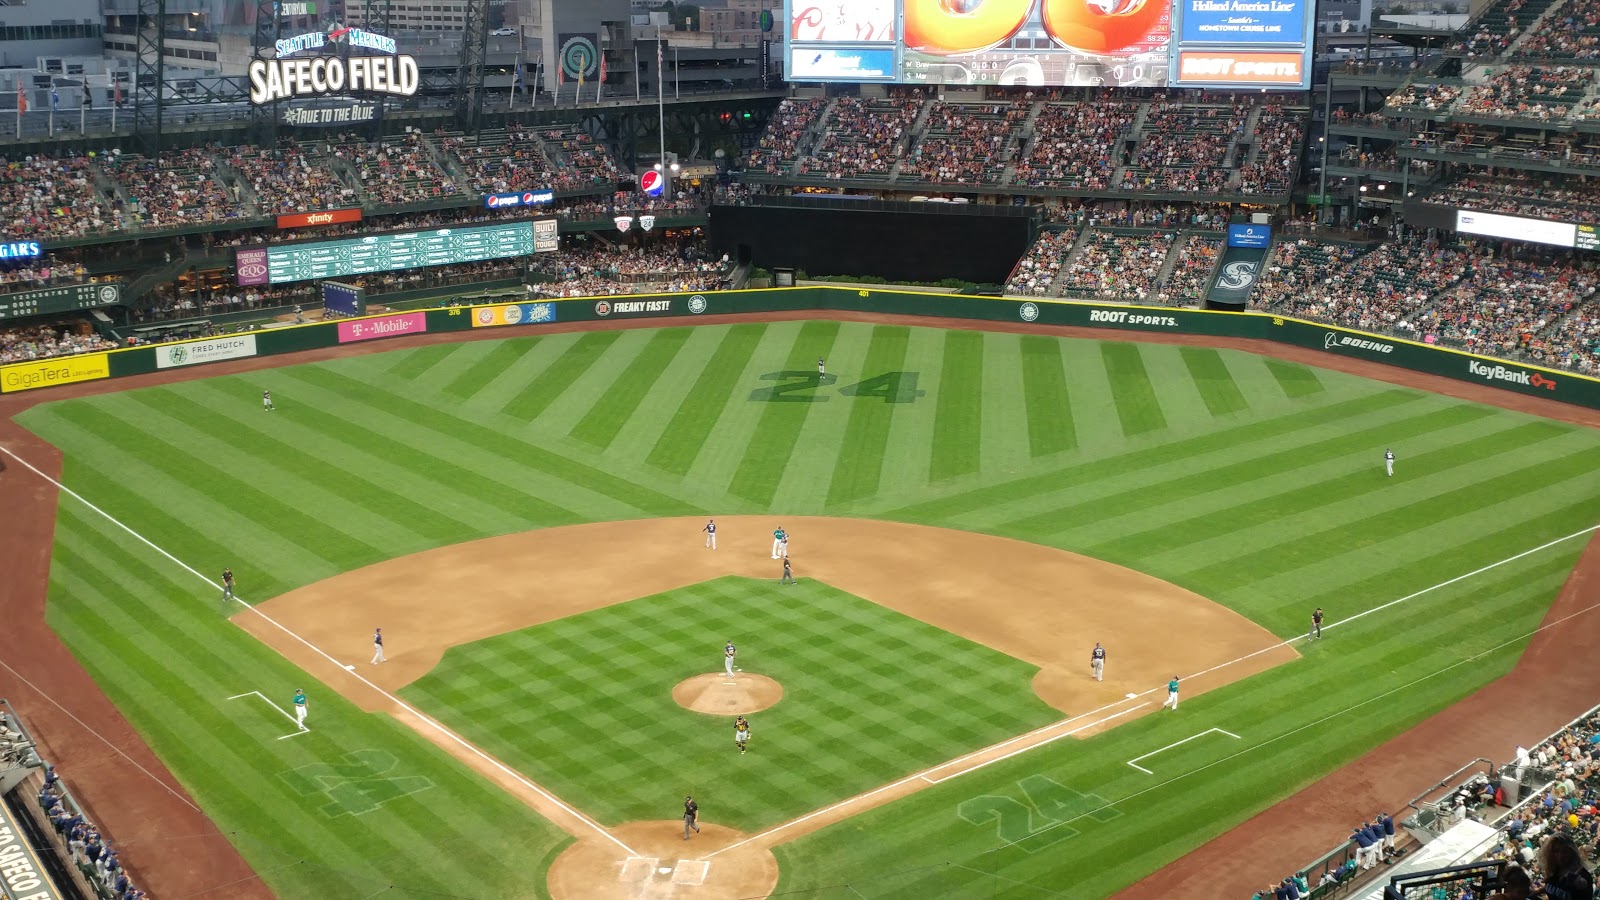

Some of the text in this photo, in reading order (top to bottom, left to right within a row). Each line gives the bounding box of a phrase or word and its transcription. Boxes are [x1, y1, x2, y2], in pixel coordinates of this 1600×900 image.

[1192, 1, 1293, 11] Holland America Line
[275, 28, 397, 59] SEATTLE MARINERS
[1133, 65, 1143, 80] 0
[1182, 58, 1234, 75] ROOT
[249, 54, 419, 105] SAFECO FIELD
[296, 105, 374, 124] TRUE TO THE BLUE
[499, 193, 553, 206] pepsi pepsi
[307, 213, 333, 224] xfinity
[535, 224, 555, 233] BUILT
[0, 242, 39, 257] GARS
[536, 240, 555, 249] TOUGH
[237, 252, 266, 260] EMERALD
[613, 301, 646, 313] FREAKY
[646, 300, 672, 311] FAST!
[1090, 310, 1128, 323] ROOT
[1273, 318, 1284, 326] 380
[192, 340, 245, 354] FRED HUTCH
[1340, 336, 1394, 355] BOEING
[6, 367, 70, 388] GigaTera
[1469, 359, 1530, 385] KeyBank
[747, 371, 926, 403] 24
[0, 844, 41, 891] SAFECO
